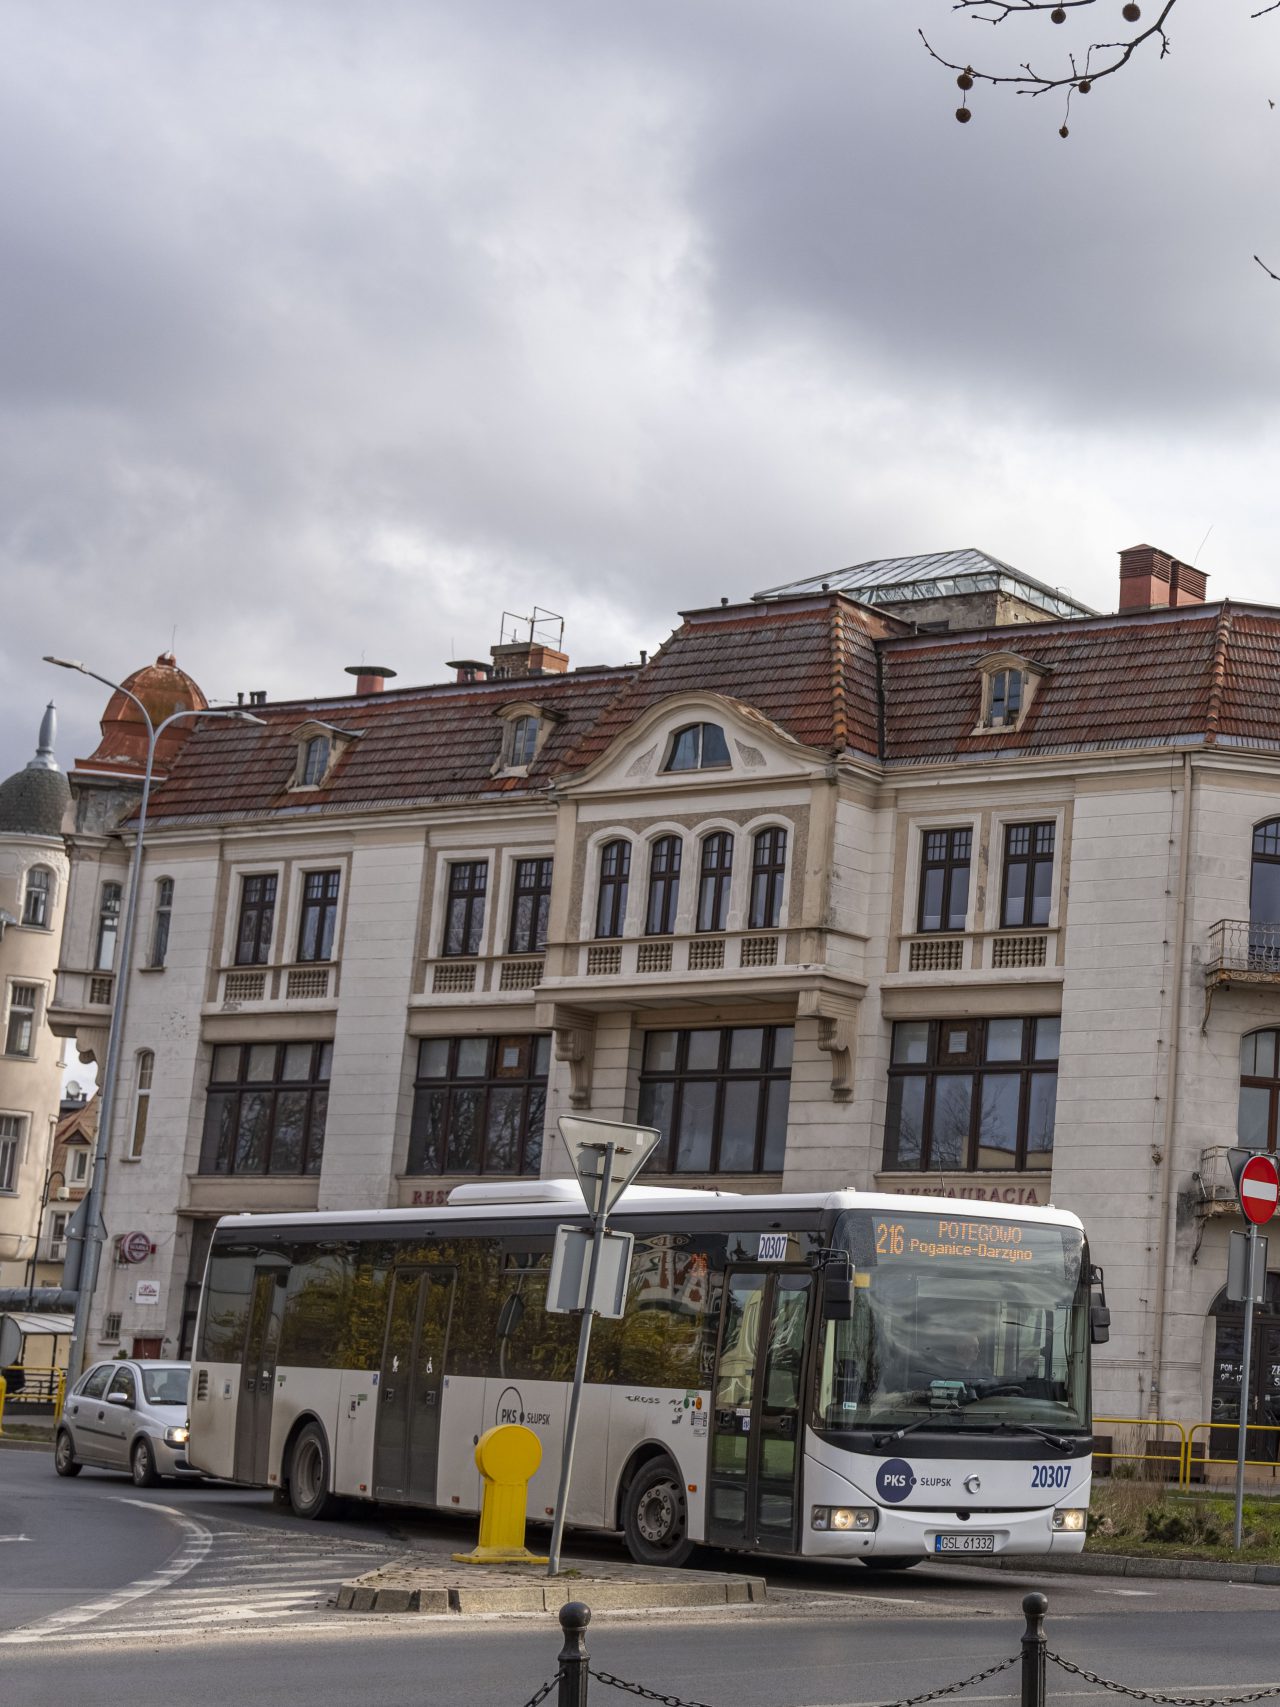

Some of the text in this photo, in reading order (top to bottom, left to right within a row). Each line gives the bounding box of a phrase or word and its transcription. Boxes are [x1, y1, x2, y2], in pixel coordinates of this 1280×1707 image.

[876, 1223, 905, 1255] 216
[938, 1221, 1023, 1244] POTEGOWO
[759, 1236, 787, 1259] 20307
[909, 1238, 1033, 1264] Poganice-Darzyno
[501, 1409, 551, 1425] PKS SŁUPSK
[883, 1474, 952, 1487] PKS SŁUPSK
[1031, 1465, 1072, 1488] 20307
[942, 1536, 993, 1550] GSL 61332
